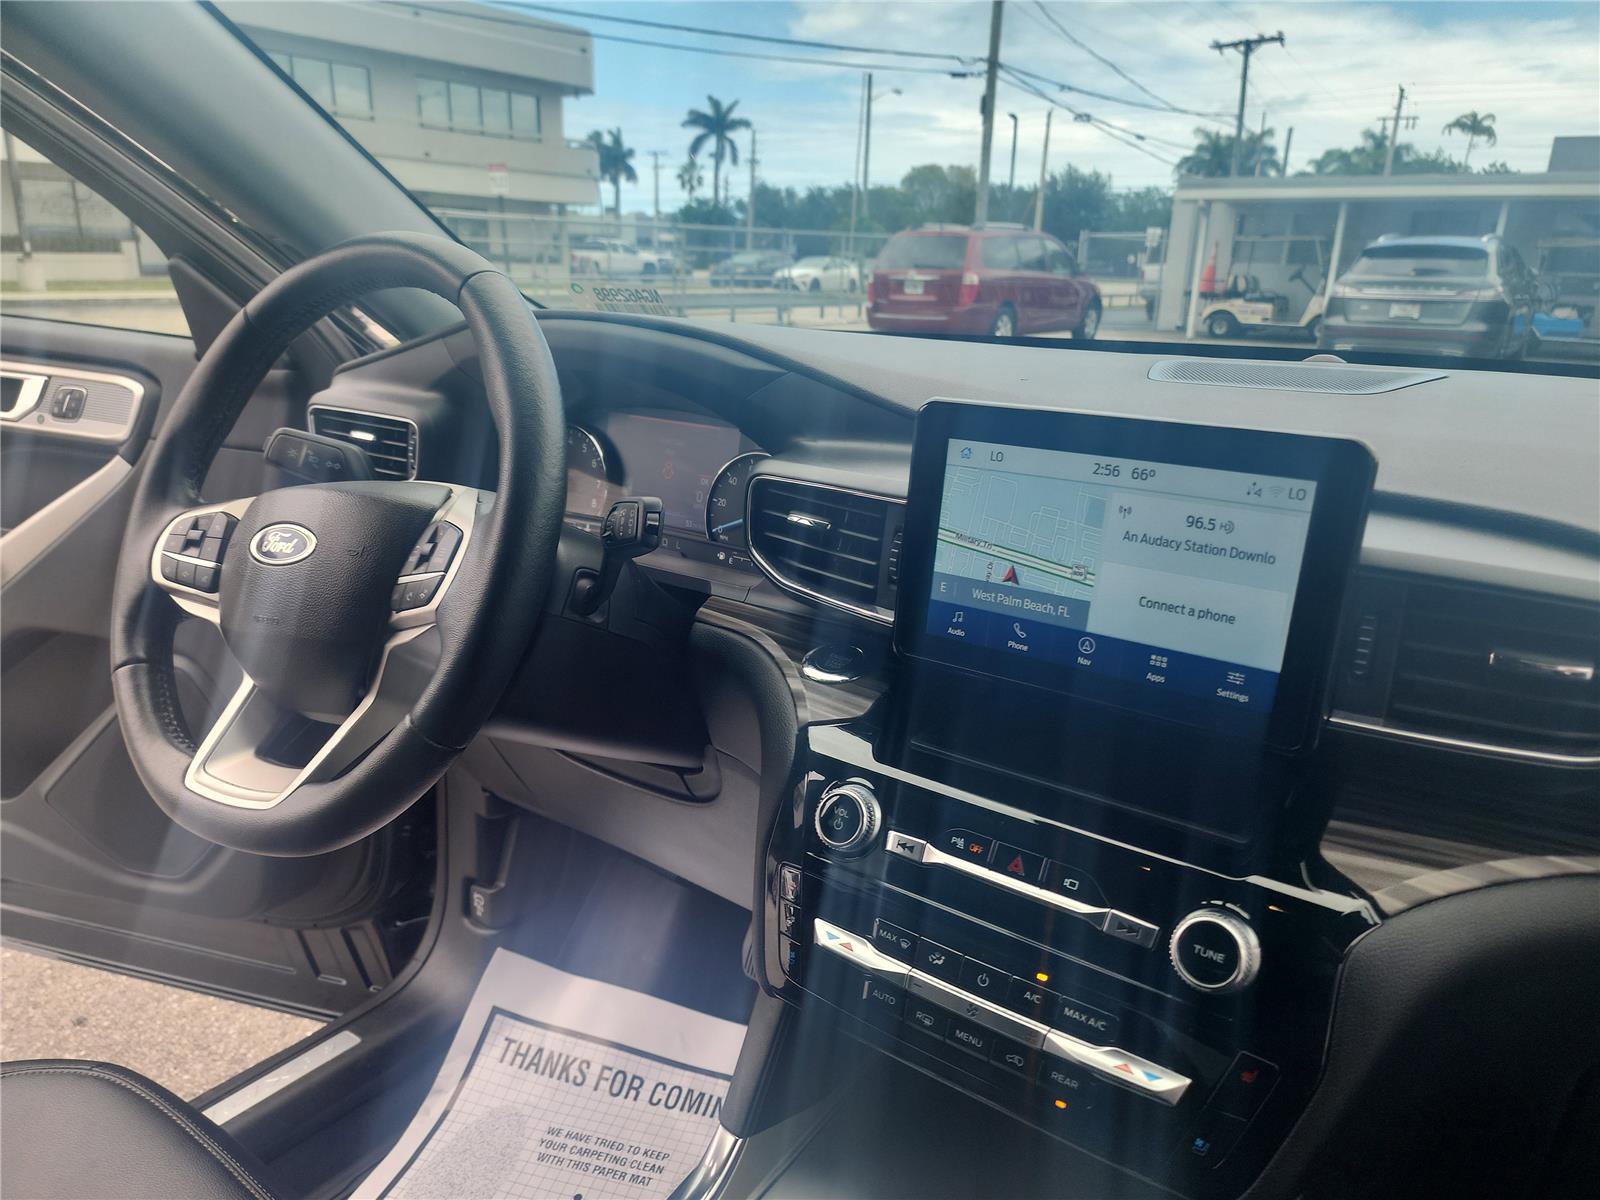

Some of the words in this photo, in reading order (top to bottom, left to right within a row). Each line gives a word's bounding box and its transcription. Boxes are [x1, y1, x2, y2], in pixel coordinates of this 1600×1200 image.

[990, 450, 1004, 463] LO
[1092, 463, 1120, 478] 2:56
[728, 477, 738, 486] 40
[1288, 487, 1306, 501] LO
[717, 498, 727, 507] 20
[1185, 515, 1216, 531] 96.5
[262, 532, 298, 553] Ford
[1122, 530, 1138, 543] An
[1140, 533, 1182, 551] Audacy
[1184, 539, 1227, 557] Station
[1229, 547, 1276, 565] Downlo
[940, 582, 947, 593] E
[972, 587, 996, 603] West
[997, 593, 1022, 608] Palm
[1023, 598, 1056, 616] Beach,
[1058, 605, 1071, 618] FL
[1139, 596, 1186, 616] Connect
[1188, 607, 1195, 617] a
[1197, 607, 1236, 625] phone
[947, 627, 965, 637] Audio
[1007, 640, 1029, 652] Phone
[1077, 656, 1092, 666] Nav
[1146, 672, 1166, 684] Apps
[1216, 688, 1249, 703] Settings
[834, 806, 849, 819] VOL
[969, 843, 984, 855] OFF
[880, 929, 897, 943] MAX
[1193, 944, 1226, 964] TUNE
[872, 989, 896, 1005] AUTO
[1023, 990, 1041, 1005] A/C
[1063, 1006, 1087, 1025] MAX
[1087, 1017, 1107, 1032] A/C
[955, 1029, 983, 1048] MENU
[497, 1037, 591, 1087] THANKS
[594, 1067, 644, 1101] FOR
[1050, 1071, 1079, 1090] REAR
[547, 1127, 563, 1137] WE
[565, 1130, 592, 1143] HAVE
[594, 1137, 624, 1152] TRIED
[627, 1145, 641, 1156] TO
[643, 1148, 670, 1162] KEEP
[539, 1138, 567, 1152] YOUR
[569, 1145, 627, 1167] CARPETING
[629, 1160, 665, 1175] CLEAN
[537, 1152, 565, 1167] WITH
[566, 1159, 590, 1173] THIS
[592, 1166, 627, 1182] PAPER
[628, 1175, 653, 1187] MAT
